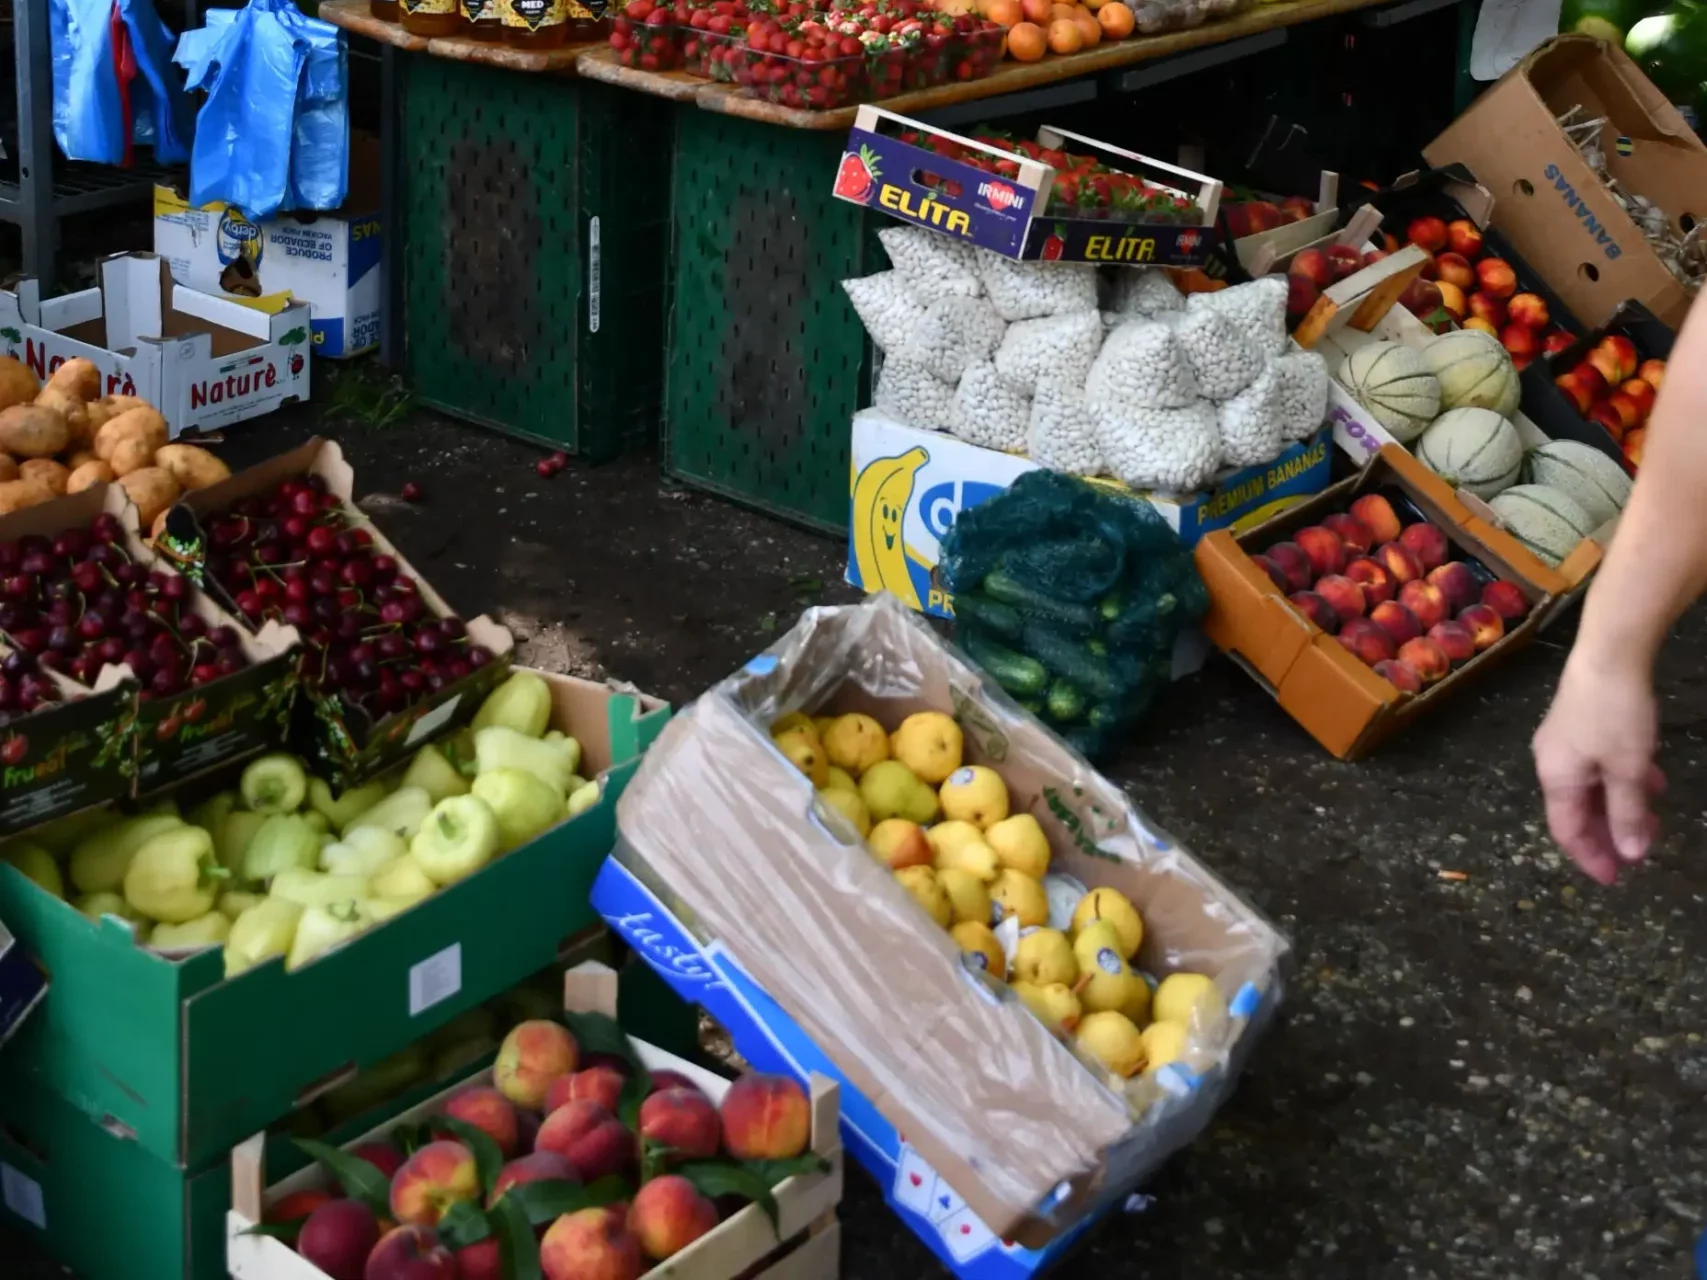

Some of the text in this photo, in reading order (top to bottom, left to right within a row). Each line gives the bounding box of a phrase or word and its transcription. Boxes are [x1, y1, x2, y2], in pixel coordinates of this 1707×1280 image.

[521, 0, 545, 9] MED
[977, 181, 1024, 210] IRMINI
[879, 183, 970, 236] ELITA
[1544, 164, 1622, 260] BANANAS
[269, 233, 333, 252] OF ECUADOR
[286, 246, 333, 262] PRODUCE
[1084, 235, 1156, 261] ELITA
[1267, 443, 1327, 490] BANANAS
